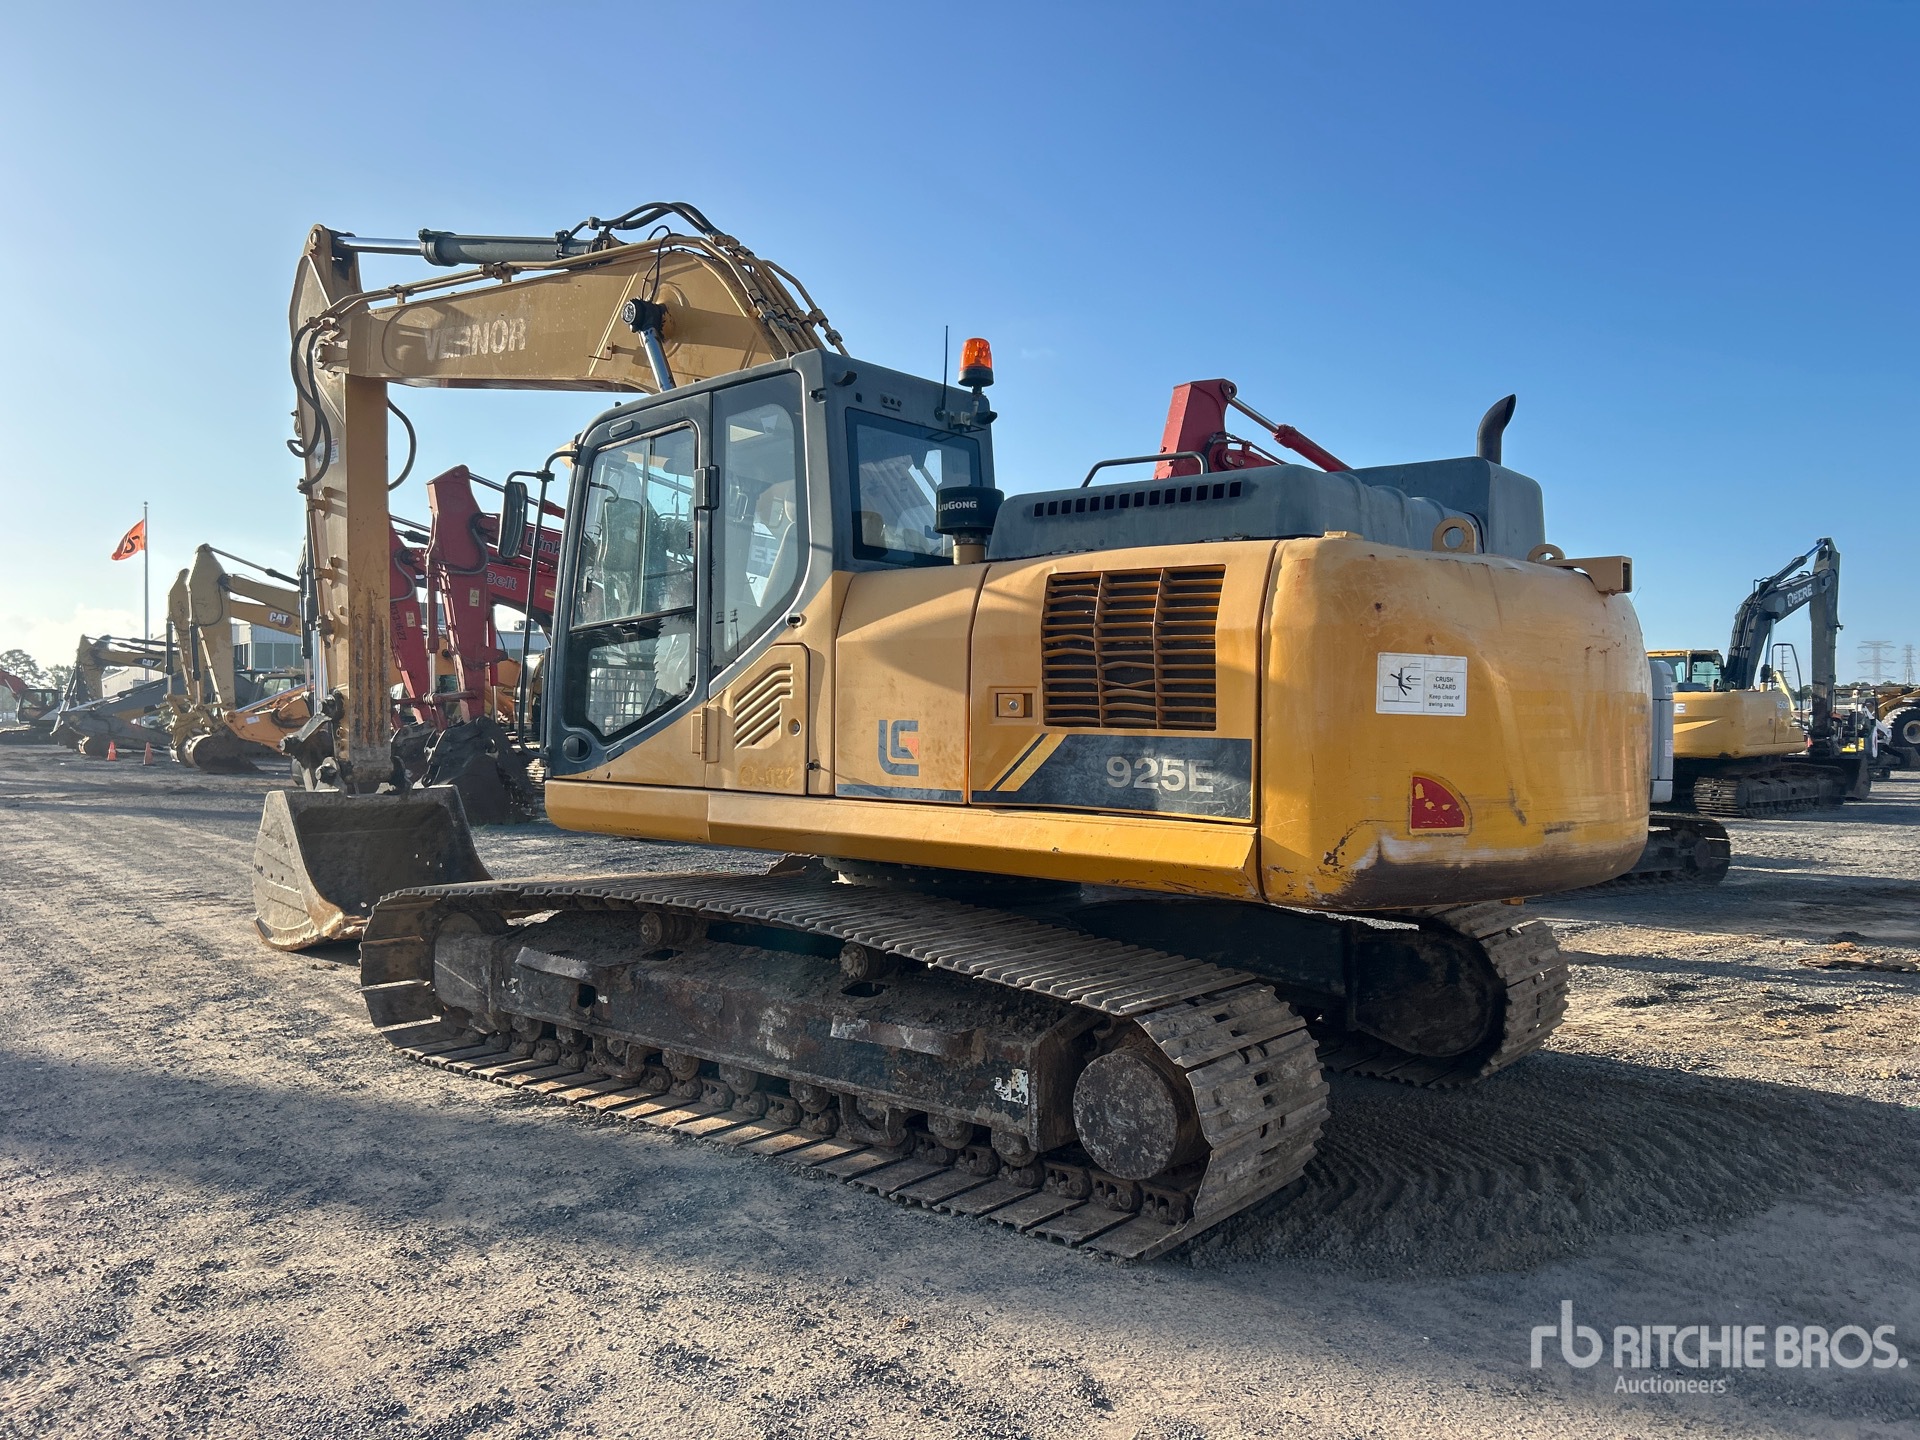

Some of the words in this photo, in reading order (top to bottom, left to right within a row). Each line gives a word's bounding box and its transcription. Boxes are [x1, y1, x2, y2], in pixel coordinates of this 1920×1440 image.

[269, 611, 289, 625] CAT
[142, 658, 155, 667] CAT
[1106, 756, 1214, 793] 925E
